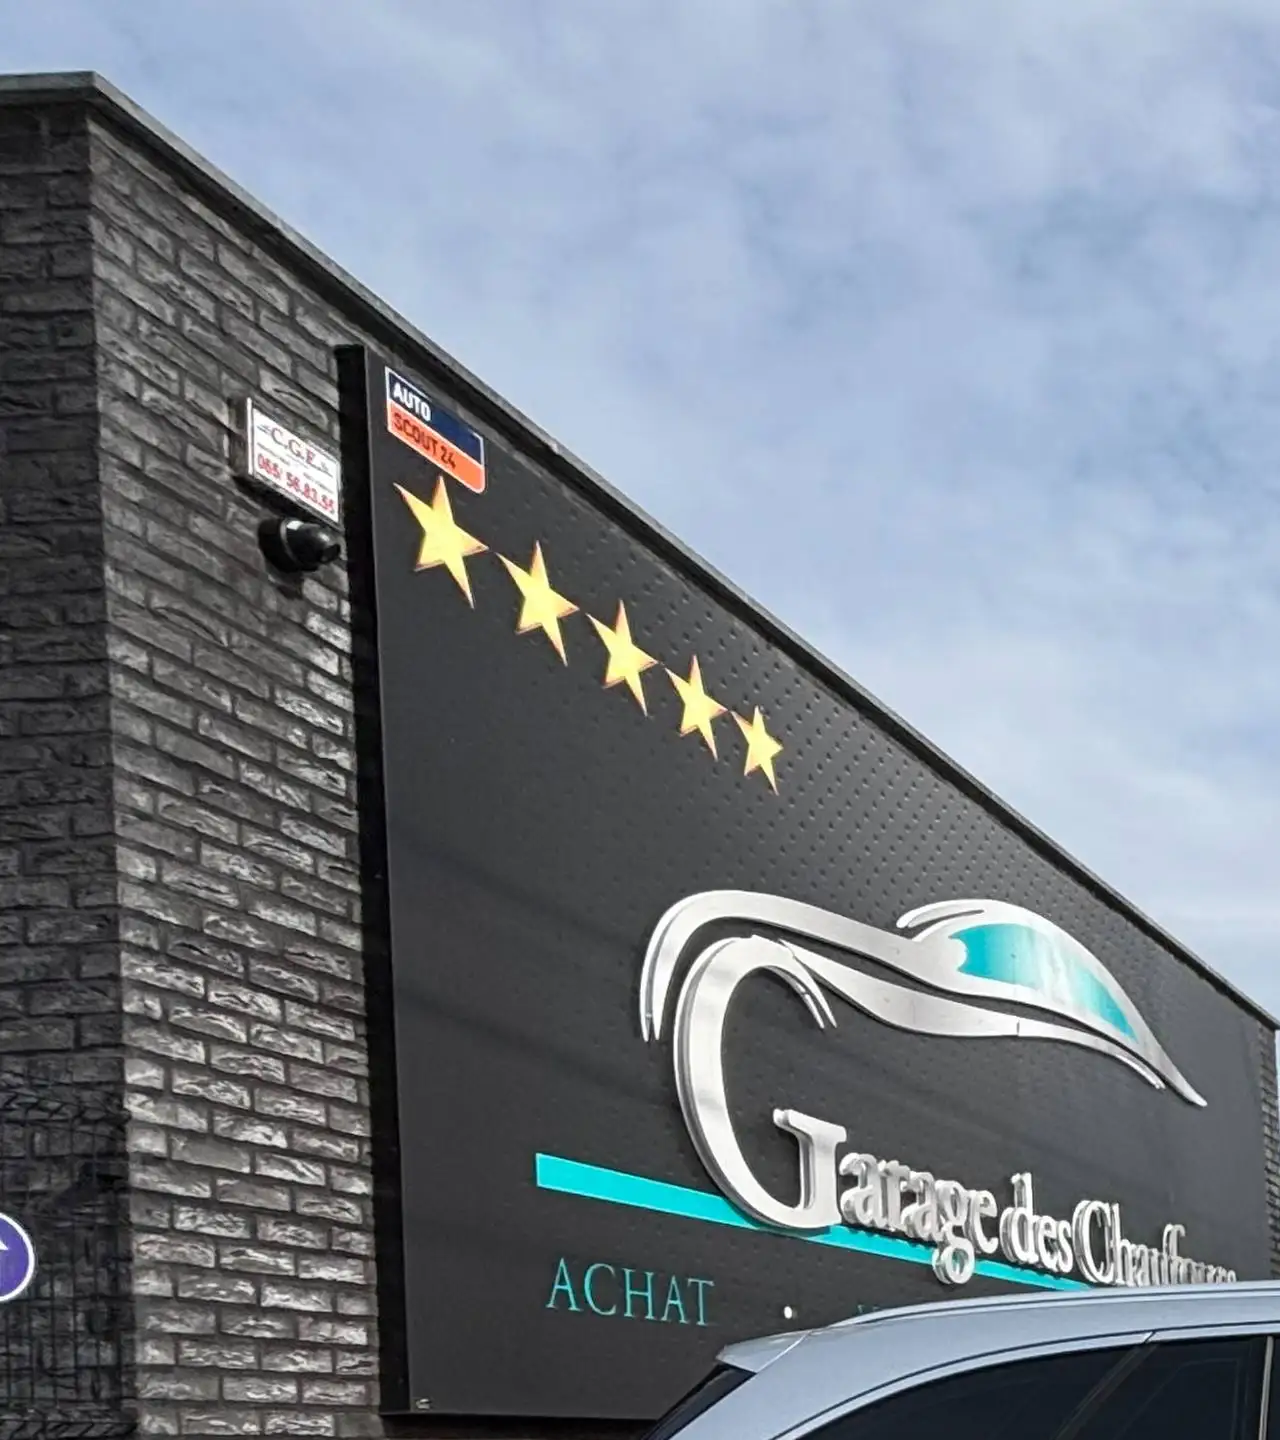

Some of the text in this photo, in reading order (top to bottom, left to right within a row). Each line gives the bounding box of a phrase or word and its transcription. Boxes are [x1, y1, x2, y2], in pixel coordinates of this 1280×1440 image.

[393, 382, 431, 422] AUTO
[675, 935, 999, 1284] Garage
[1000, 1172, 1073, 1273] des
[546, 1257, 715, 1327] ACHAT
